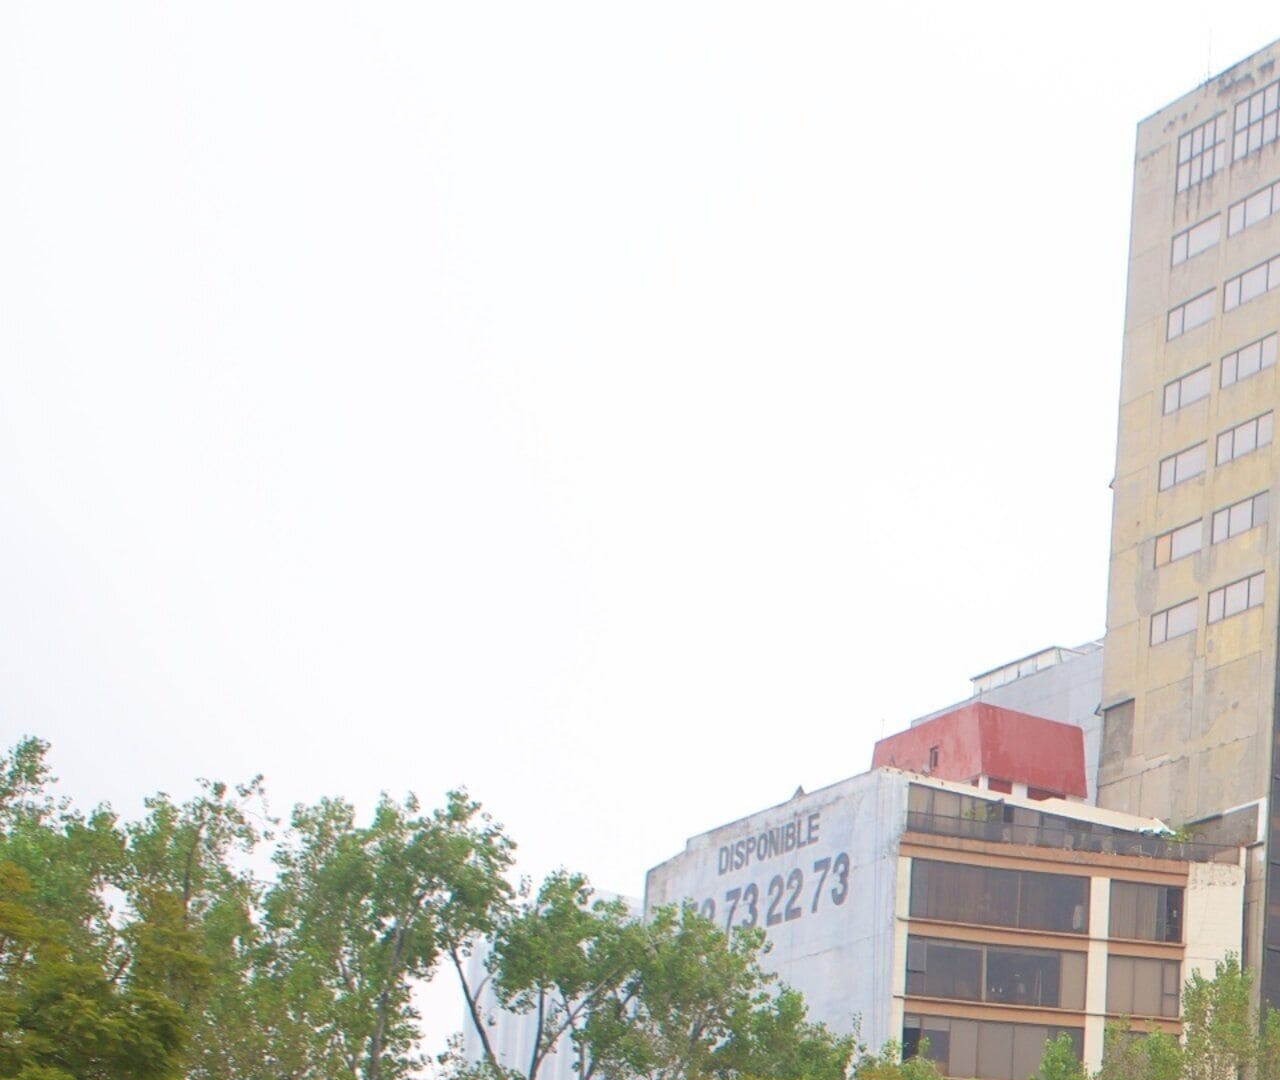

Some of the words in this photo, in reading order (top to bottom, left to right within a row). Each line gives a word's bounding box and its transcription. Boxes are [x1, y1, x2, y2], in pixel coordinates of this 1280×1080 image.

[717, 812, 820, 876] DISPONIBLE
[766, 868, 804, 926] 22
[811, 852, 850, 914] 73
